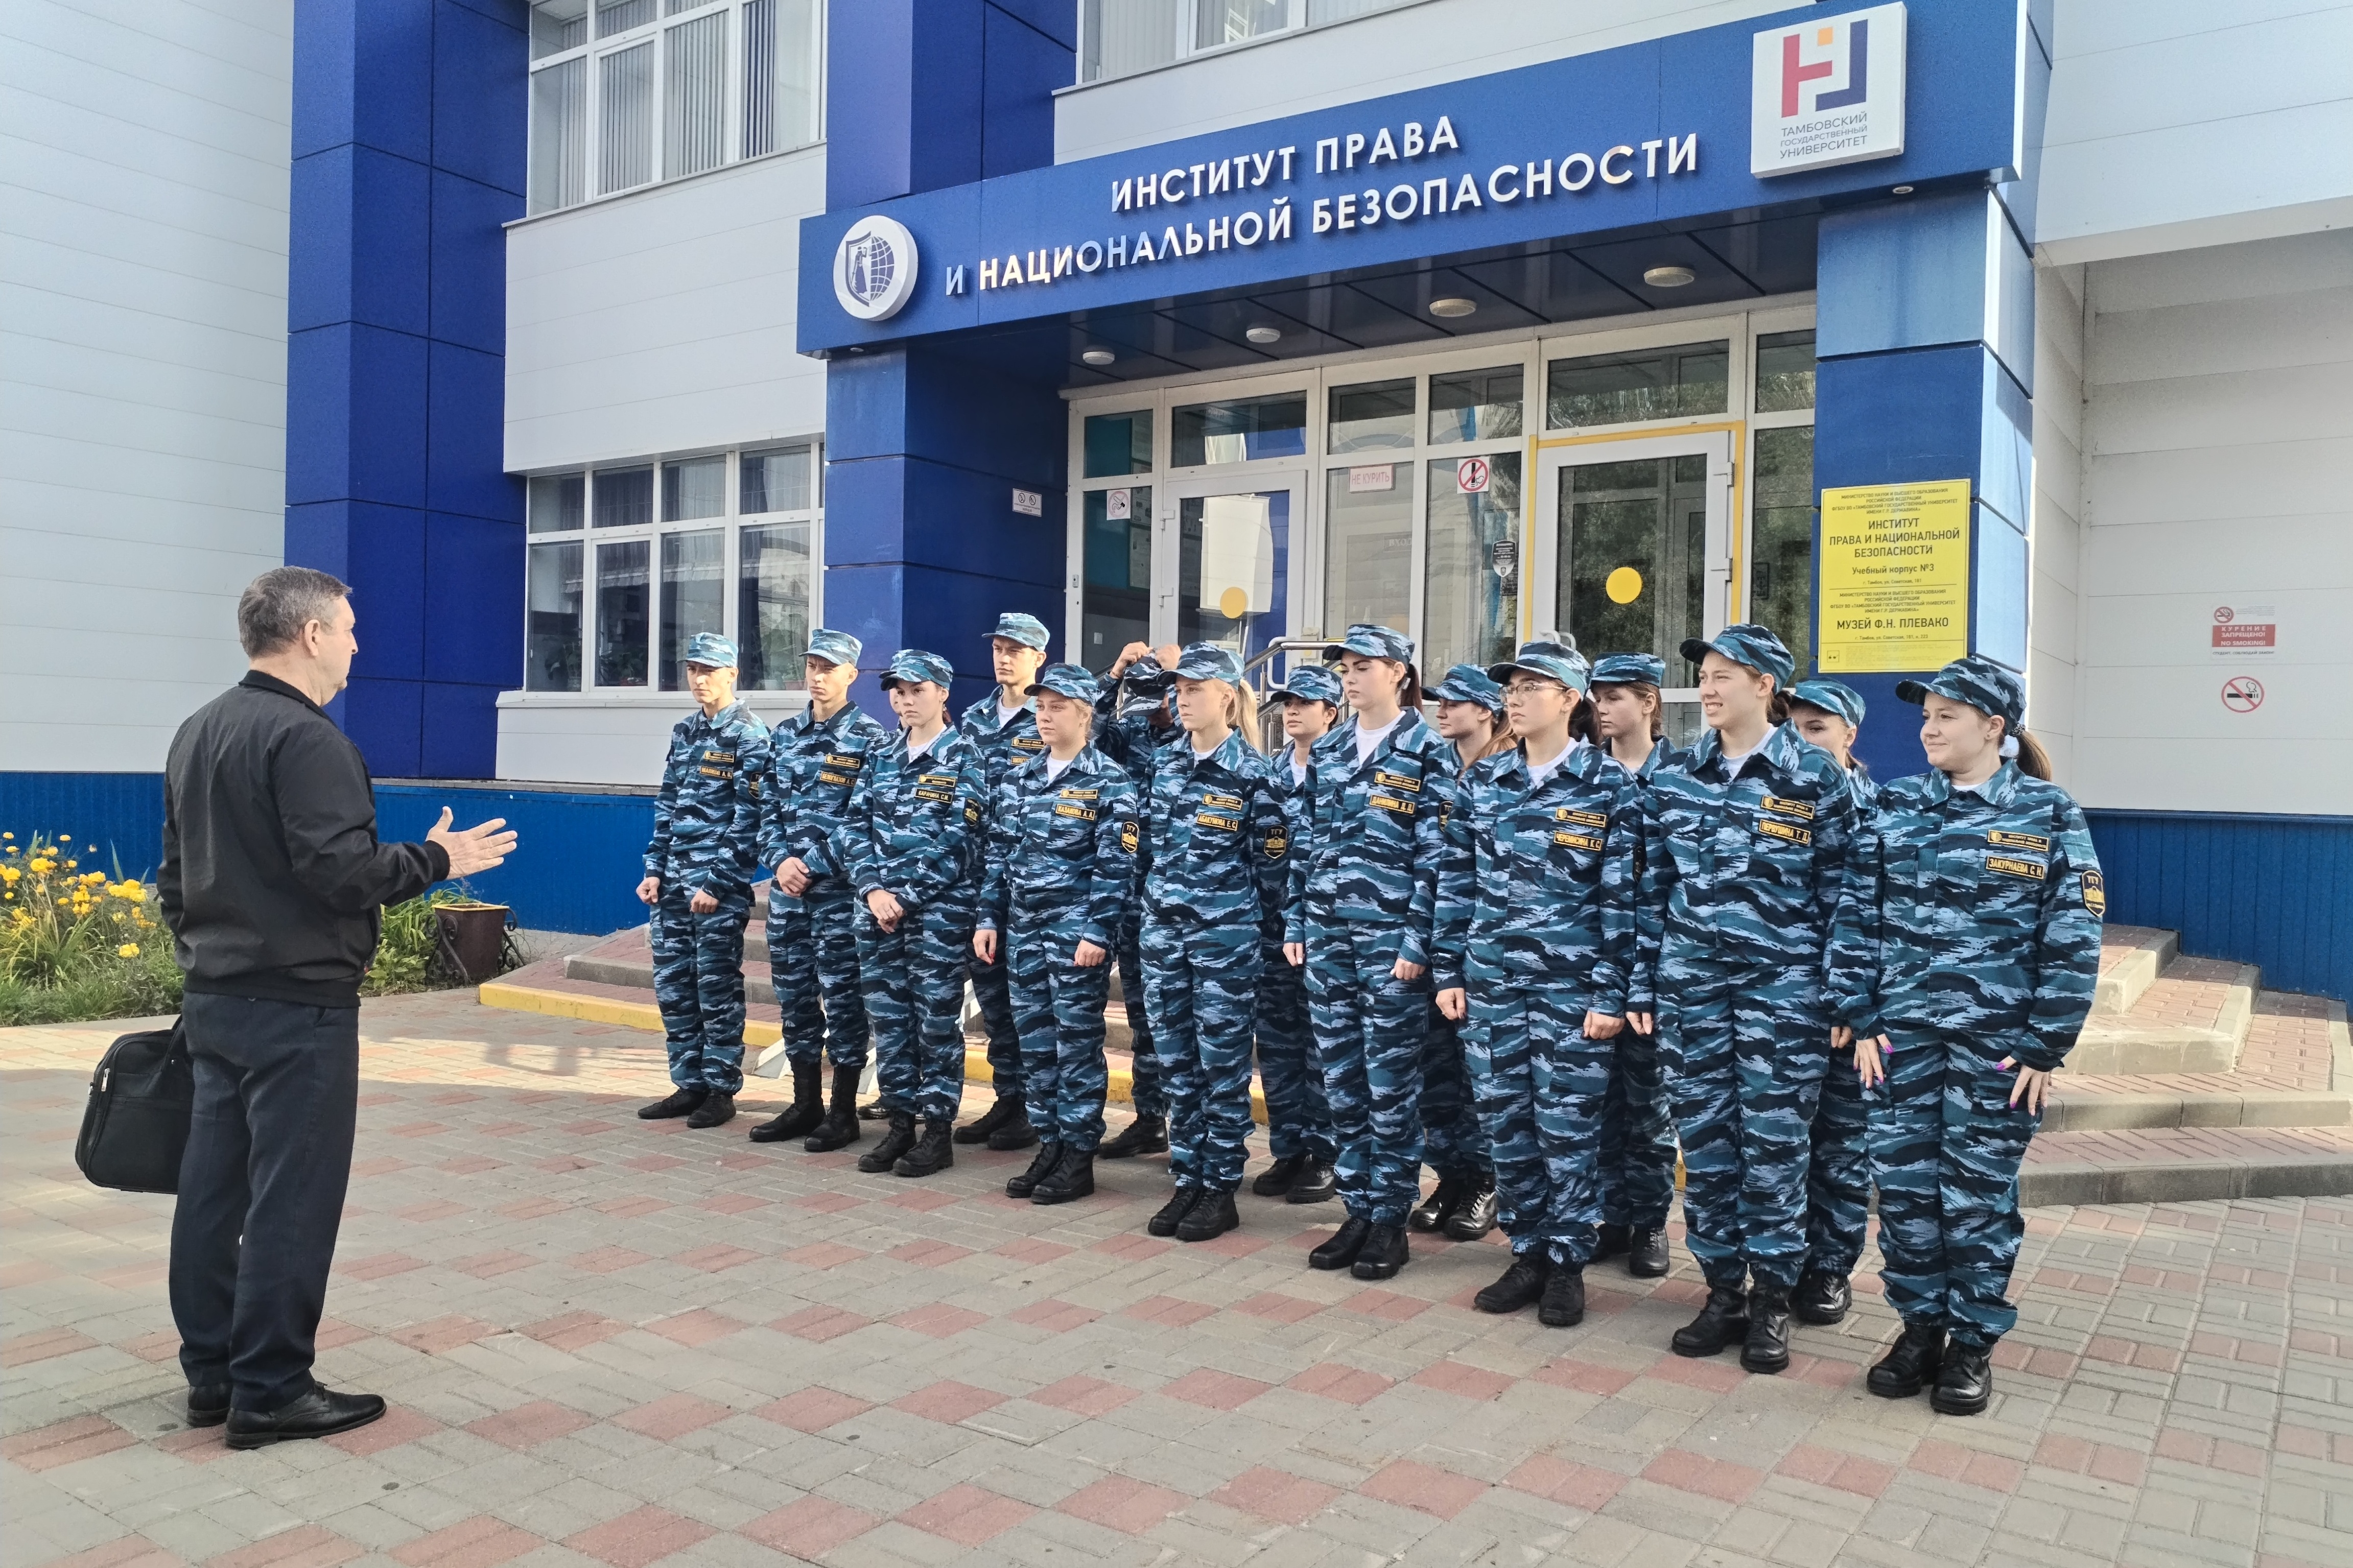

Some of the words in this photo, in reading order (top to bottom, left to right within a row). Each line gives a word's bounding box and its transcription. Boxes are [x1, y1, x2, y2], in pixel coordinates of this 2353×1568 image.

[1781, 110, 1867, 137] ТАМБОВСКИЙ
[1780, 124, 1867, 147] ГОСУДАРСТВЕННЫЙ
[1780, 135, 1868, 159] УНИВЕРСИТЕТ
[1111, 146, 1296, 212] ИНСТИТУТ
[1316, 115, 1458, 174] ПРАВА
[946, 264, 963, 296] И
[979, 196, 1292, 291] НАЦИОНАЛЬНОЙ
[1312, 133, 1697, 233] БЕЗОПАСНОСТИ
[1352, 474, 1361, 485] НЕ
[1362, 471, 1390, 484] КУРИТЬ
[1868, 517, 1920, 530] ИНСТИТУТ
[1829, 535, 1862, 545] ПРАВА
[1865, 534, 1872, 543] И
[1875, 527, 1960, 544] НАЦИОНАЛЬНОЙ
[1854, 544, 1933, 558] БЕЗОПАСНОСТИ
[1852, 565, 1887, 575] Учебный
[1889, 566, 1917, 575] корпус
[1920, 563, 1935, 572] №3
[1837, 617, 1871, 629] МУЗЕЙ
[1874, 619, 1896, 628] Ф.Н.
[1899, 617, 1949, 628] ПЛЕВАКО
[1126, 824, 1136, 833] ТГУ
[1761, 822, 1794, 838] ПЕРВУШИНА
[1989, 858, 2028, 873] ЗАКУРНАЕВА
[2086, 875, 2099, 885] ТГУ
